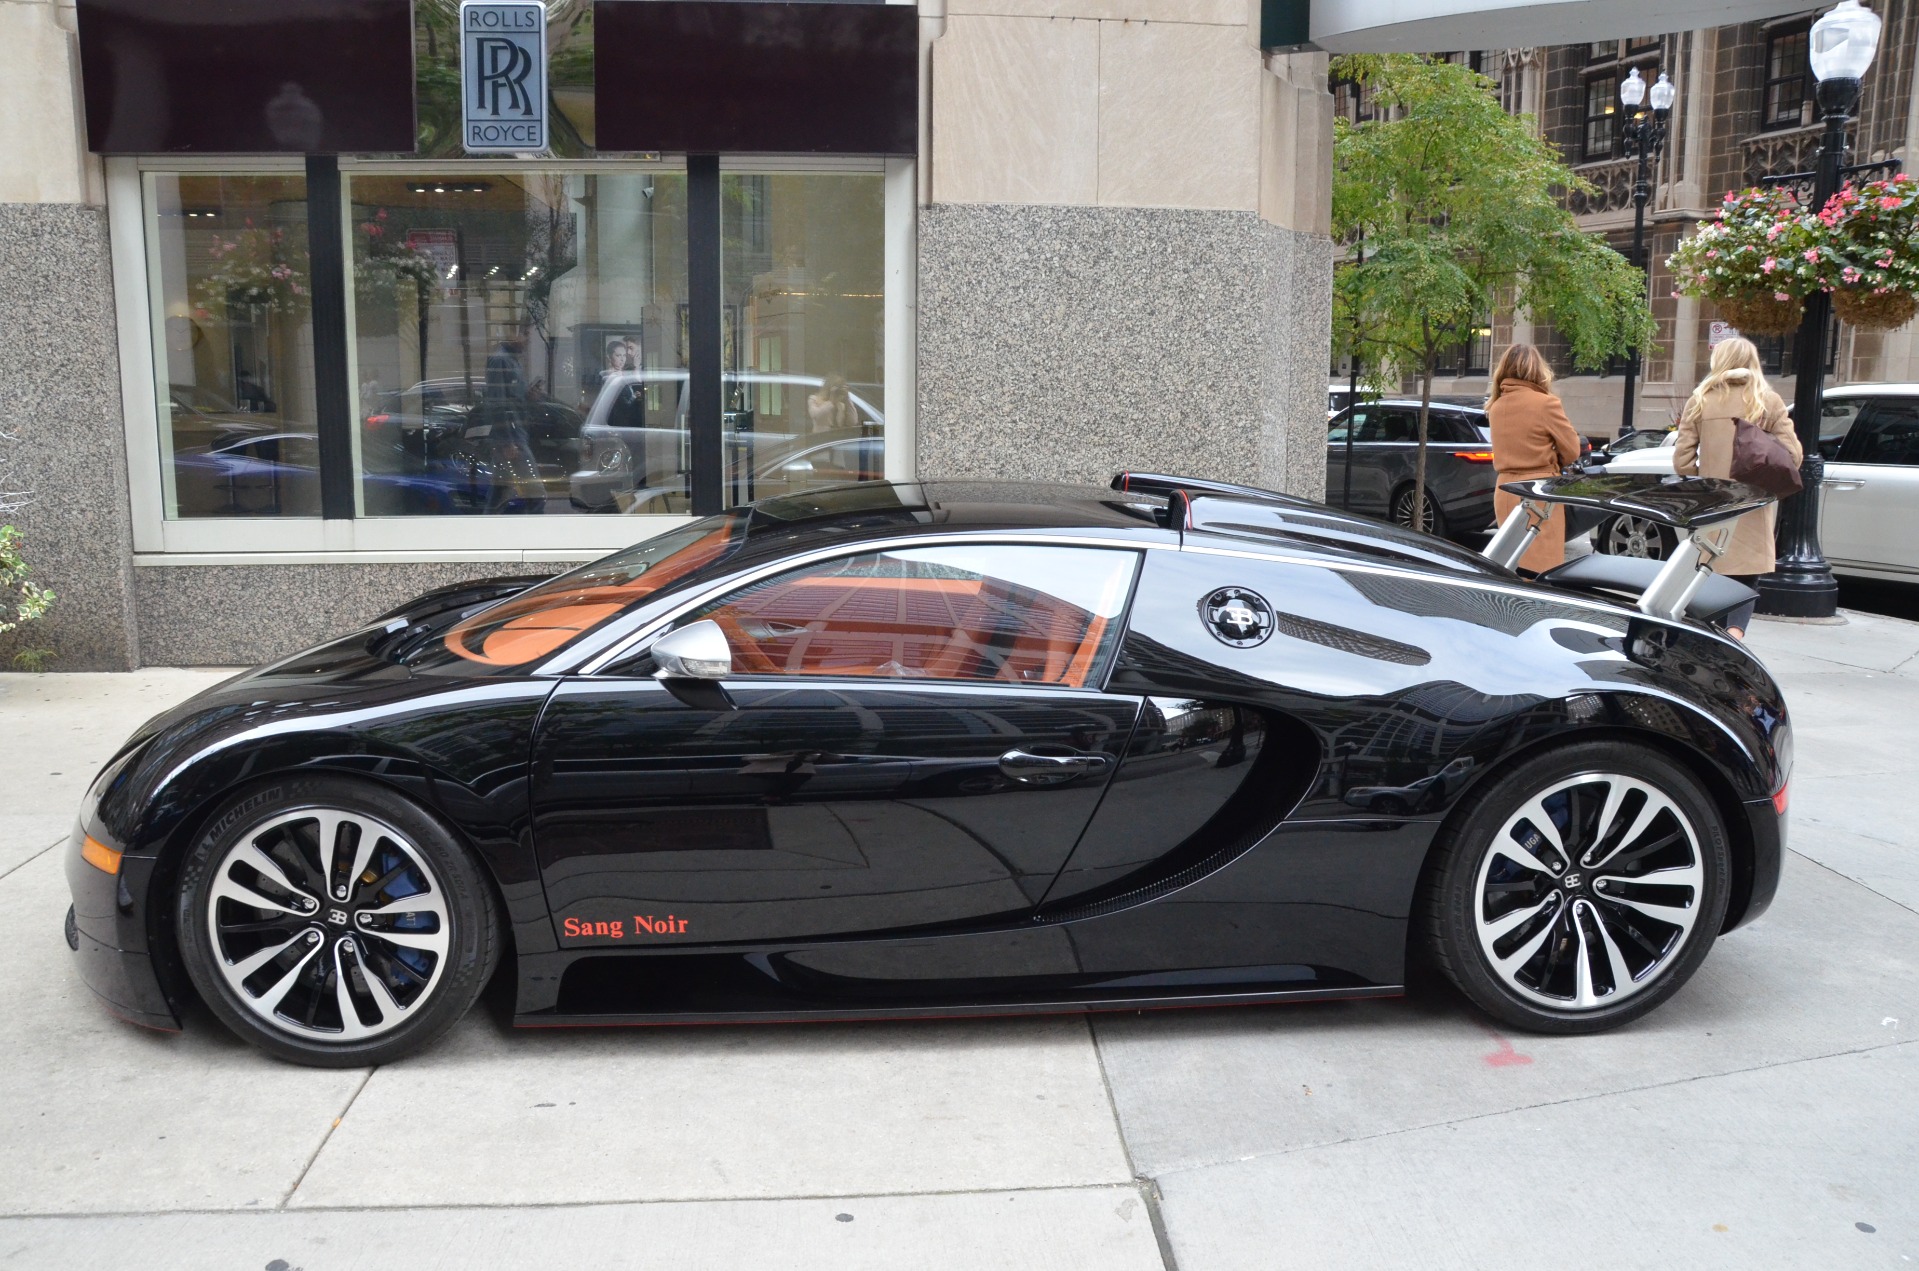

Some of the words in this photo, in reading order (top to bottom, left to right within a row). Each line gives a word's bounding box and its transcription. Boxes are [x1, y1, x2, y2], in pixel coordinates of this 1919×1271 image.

[469, 10, 535, 28] ROLLS
[472, 125, 537, 142] ROYCE
[208, 787, 282, 843] MICHELIN
[563, 917, 624, 939] Sang
[633, 914, 689, 935] Noir
